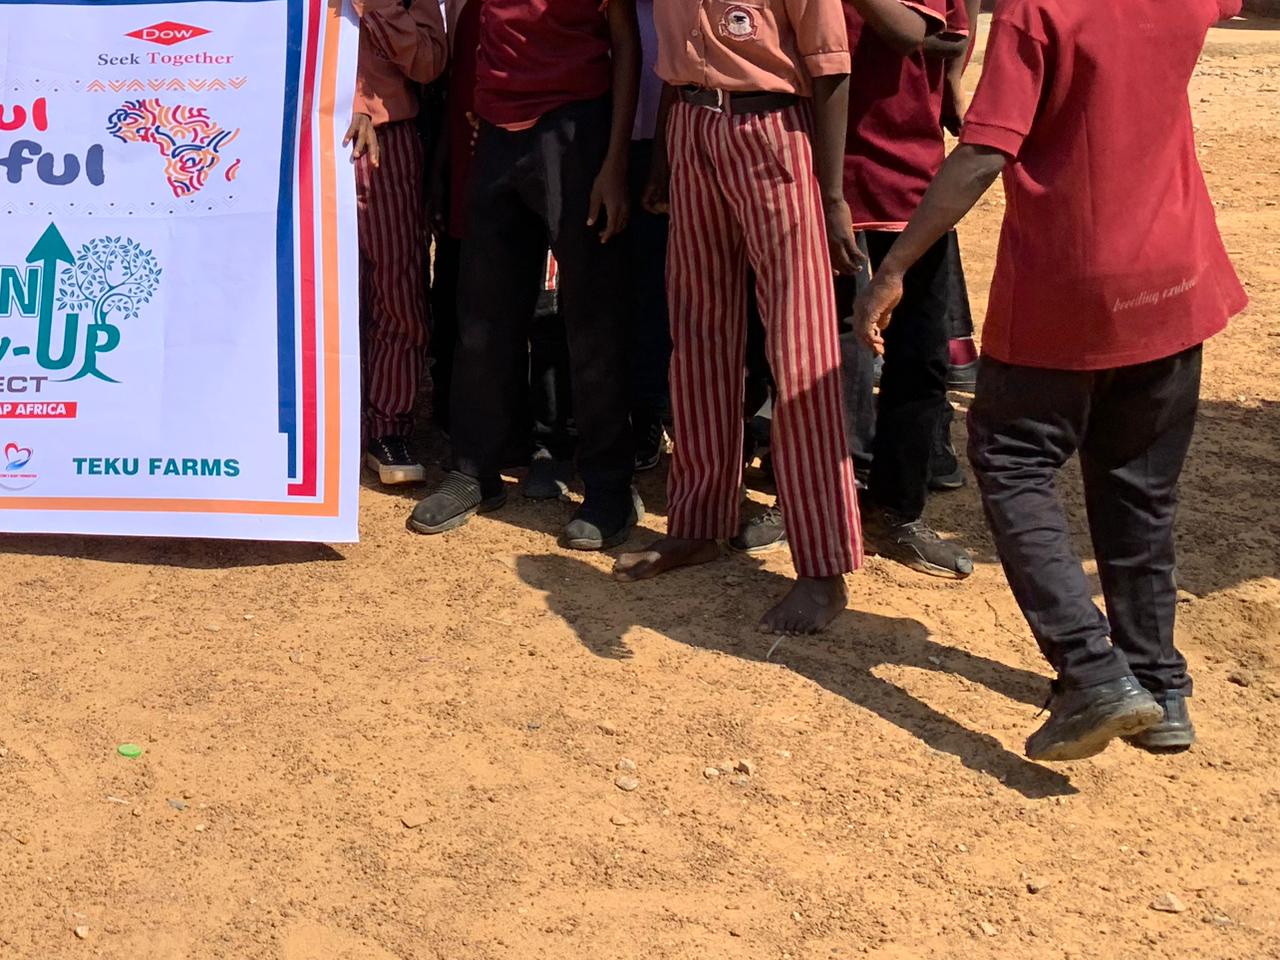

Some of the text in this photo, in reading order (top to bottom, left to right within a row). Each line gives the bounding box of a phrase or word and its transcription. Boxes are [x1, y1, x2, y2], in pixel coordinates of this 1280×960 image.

[97, 51, 234, 67] Seek Together
[15, 403, 67, 416] AFRICA
[72, 457, 241, 478] TEKU FARMS
